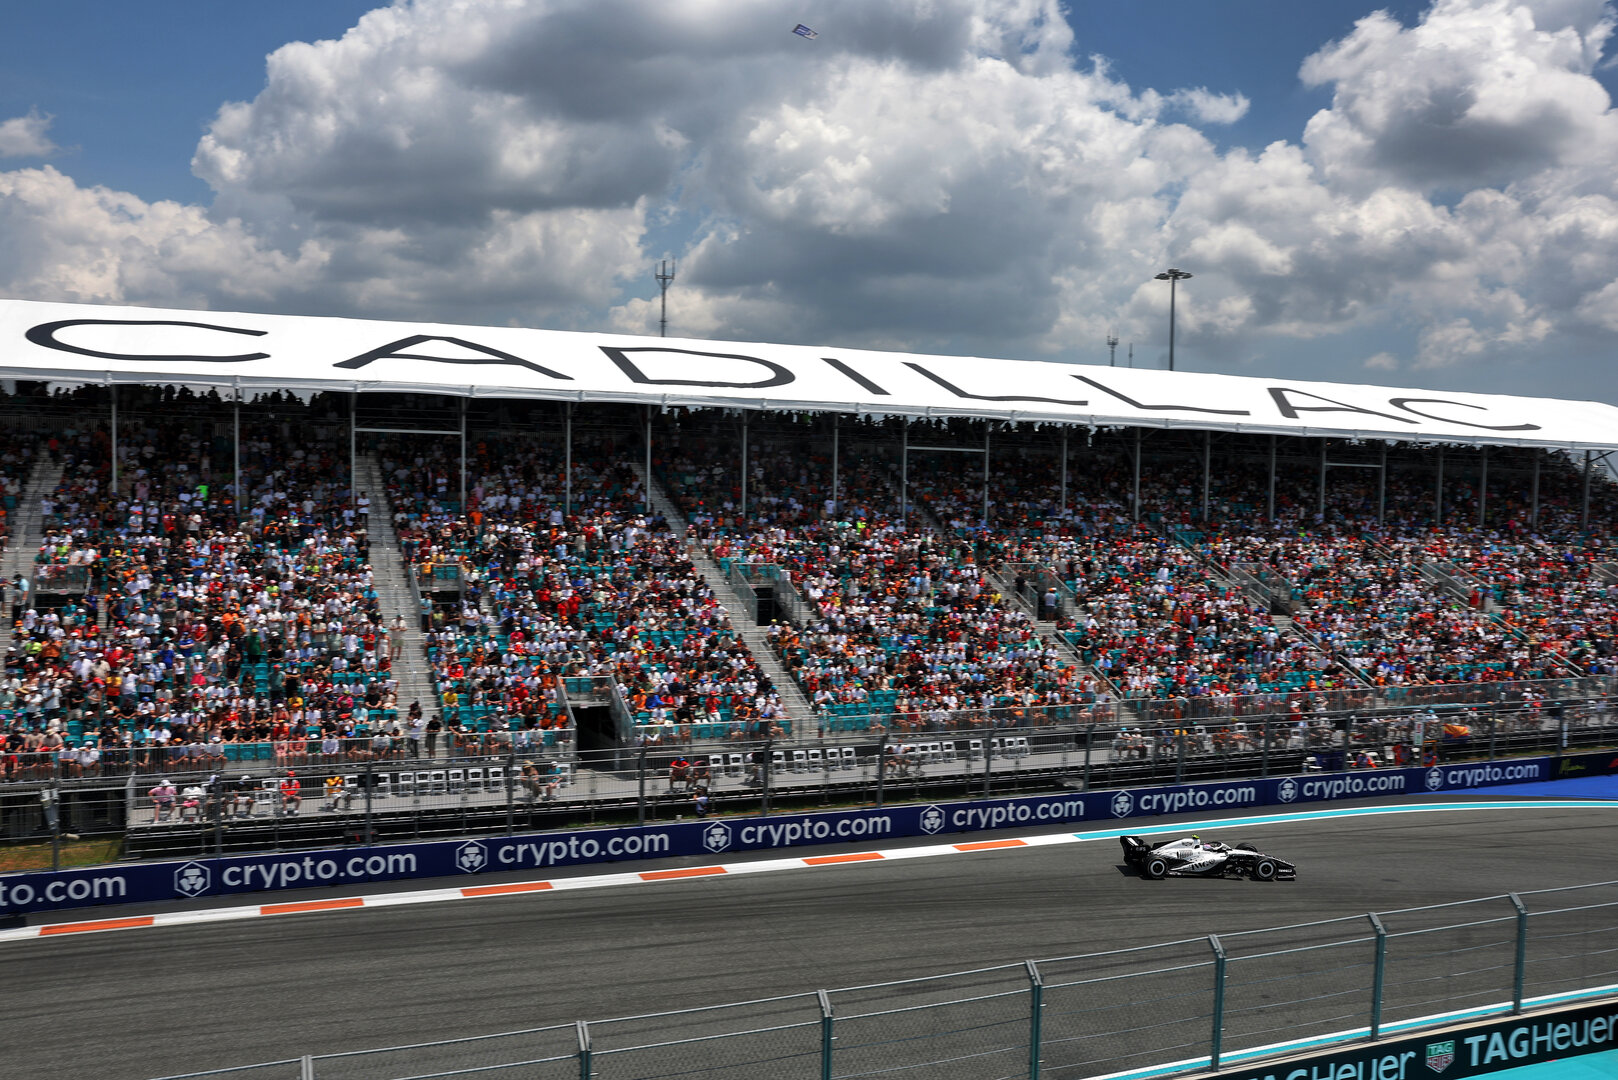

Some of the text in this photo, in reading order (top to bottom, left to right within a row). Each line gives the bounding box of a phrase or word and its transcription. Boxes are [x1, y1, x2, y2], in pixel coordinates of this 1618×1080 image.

[25, 319, 1541, 431] CADILLAC
[1303, 775, 1405, 799] crypto.com
[1448, 764, 1540, 787] crypto.com
[1140, 786, 1255, 812] crypto.com
[952, 800, 1084, 829] crypto.com
[741, 815, 891, 847] crypto.com
[498, 832, 669, 866] crypto.com
[222, 850, 417, 889] crypto.com
